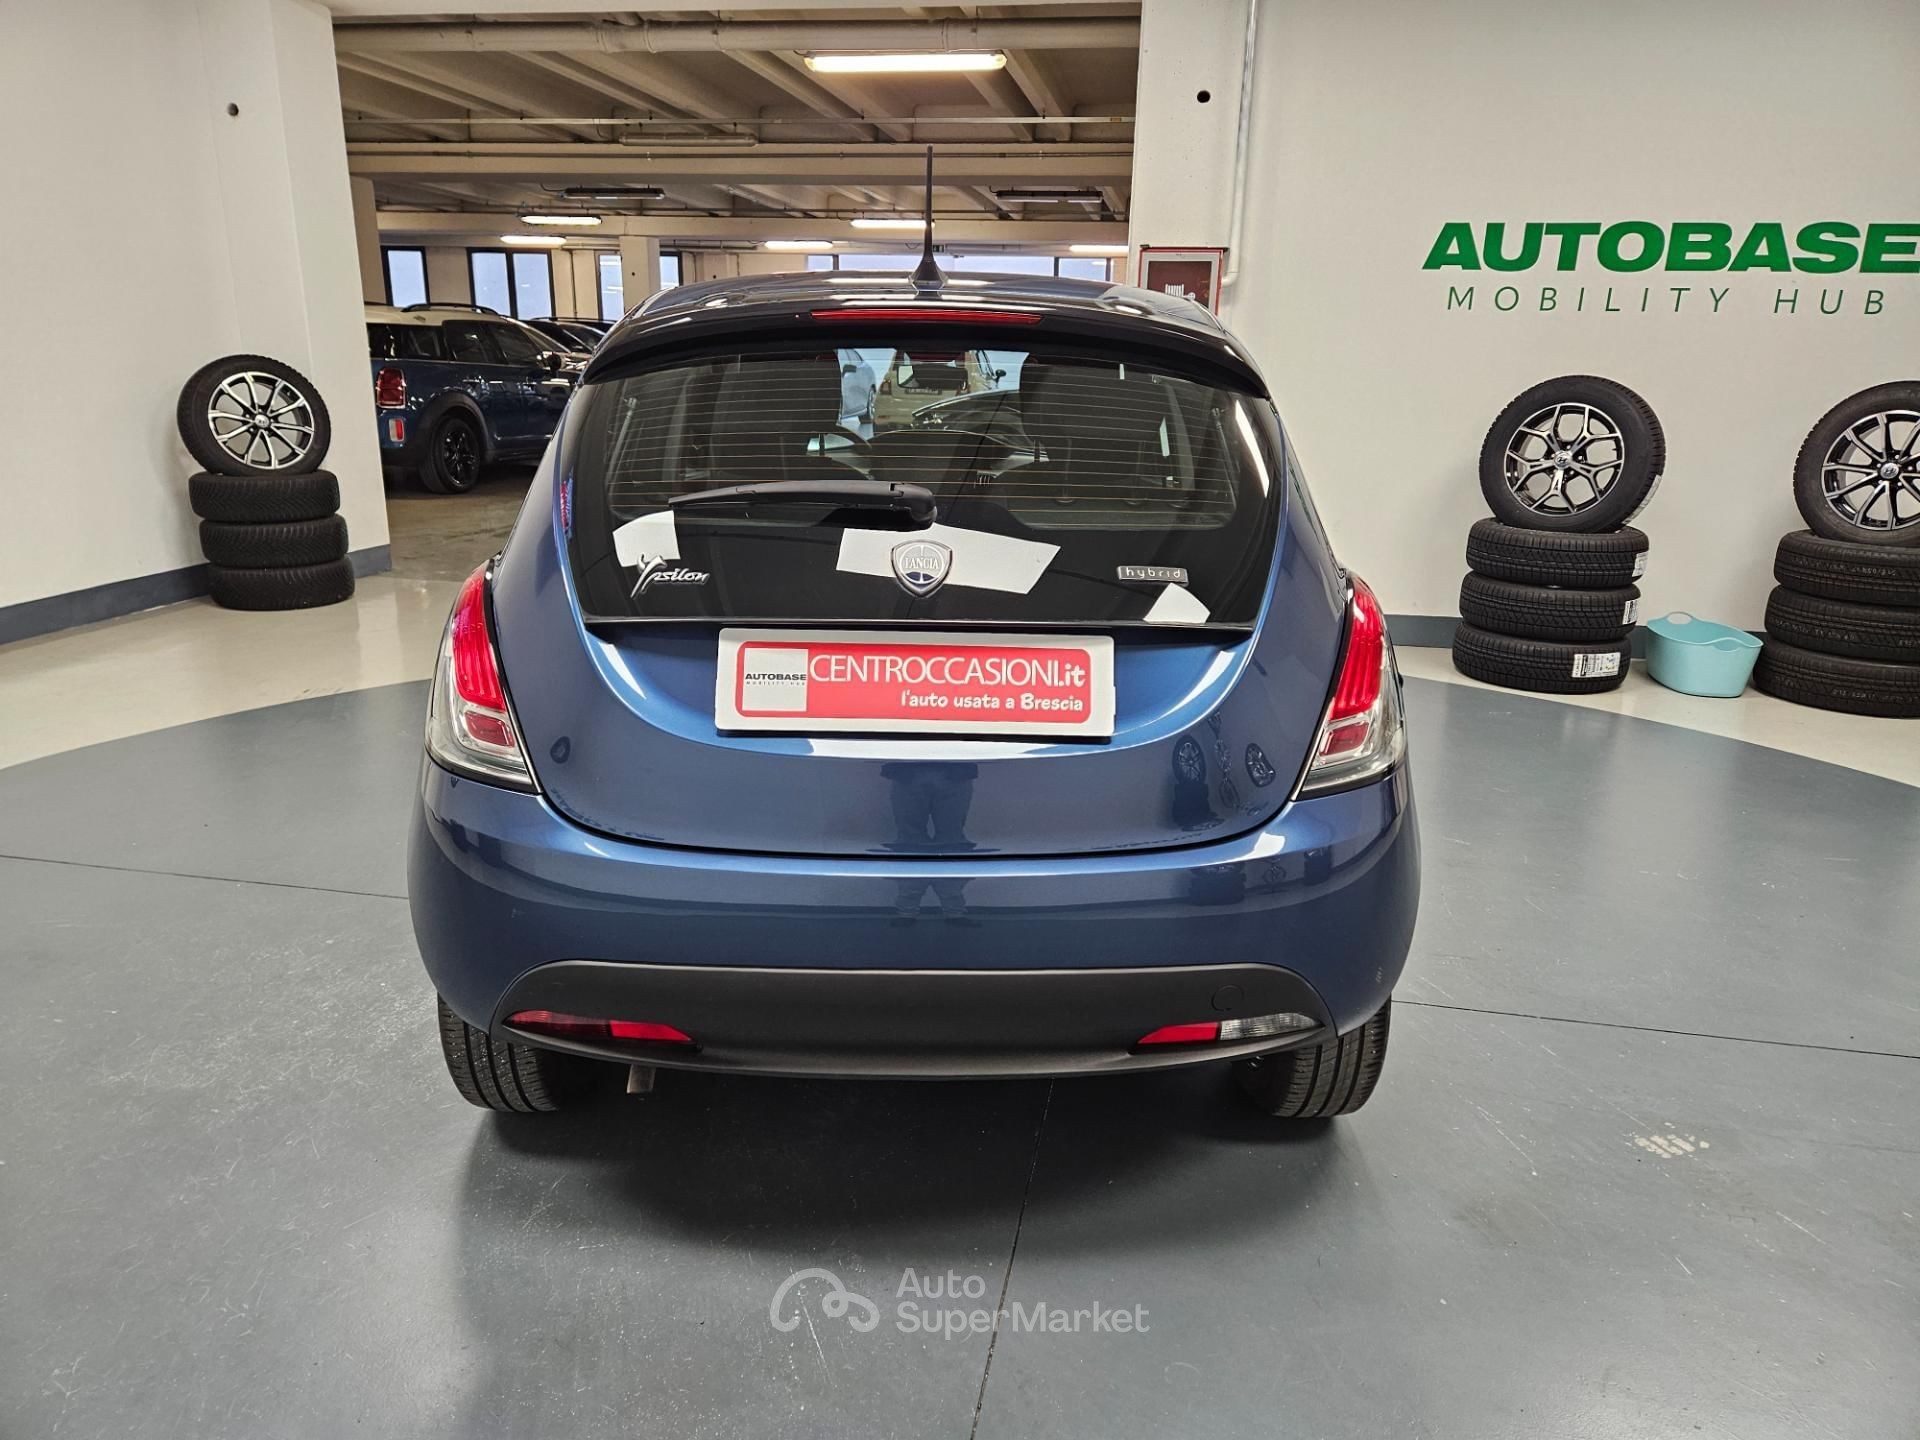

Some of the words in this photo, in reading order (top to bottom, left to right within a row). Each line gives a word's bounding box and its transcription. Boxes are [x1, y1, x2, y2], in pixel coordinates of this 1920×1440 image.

[1421, 221, 1920, 274] AUTOBASE
[1447, 286, 1729, 313] MOBILITY
[1773, 288, 1884, 315] HUB
[905, 557, 939, 569] LANCIA
[1126, 566, 1180, 578] hybrid
[630, 554, 709, 598] Ypsilon
[745, 673, 807, 681] AUTOBASE
[809, 655, 1085, 687] CENTROCCASIONI.it
[901, 690, 948, 708] l'auto
[953, 693, 1000, 709] usata
[1005, 697, 1015, 709] a
[1020, 692, 1083, 711] Brescia
